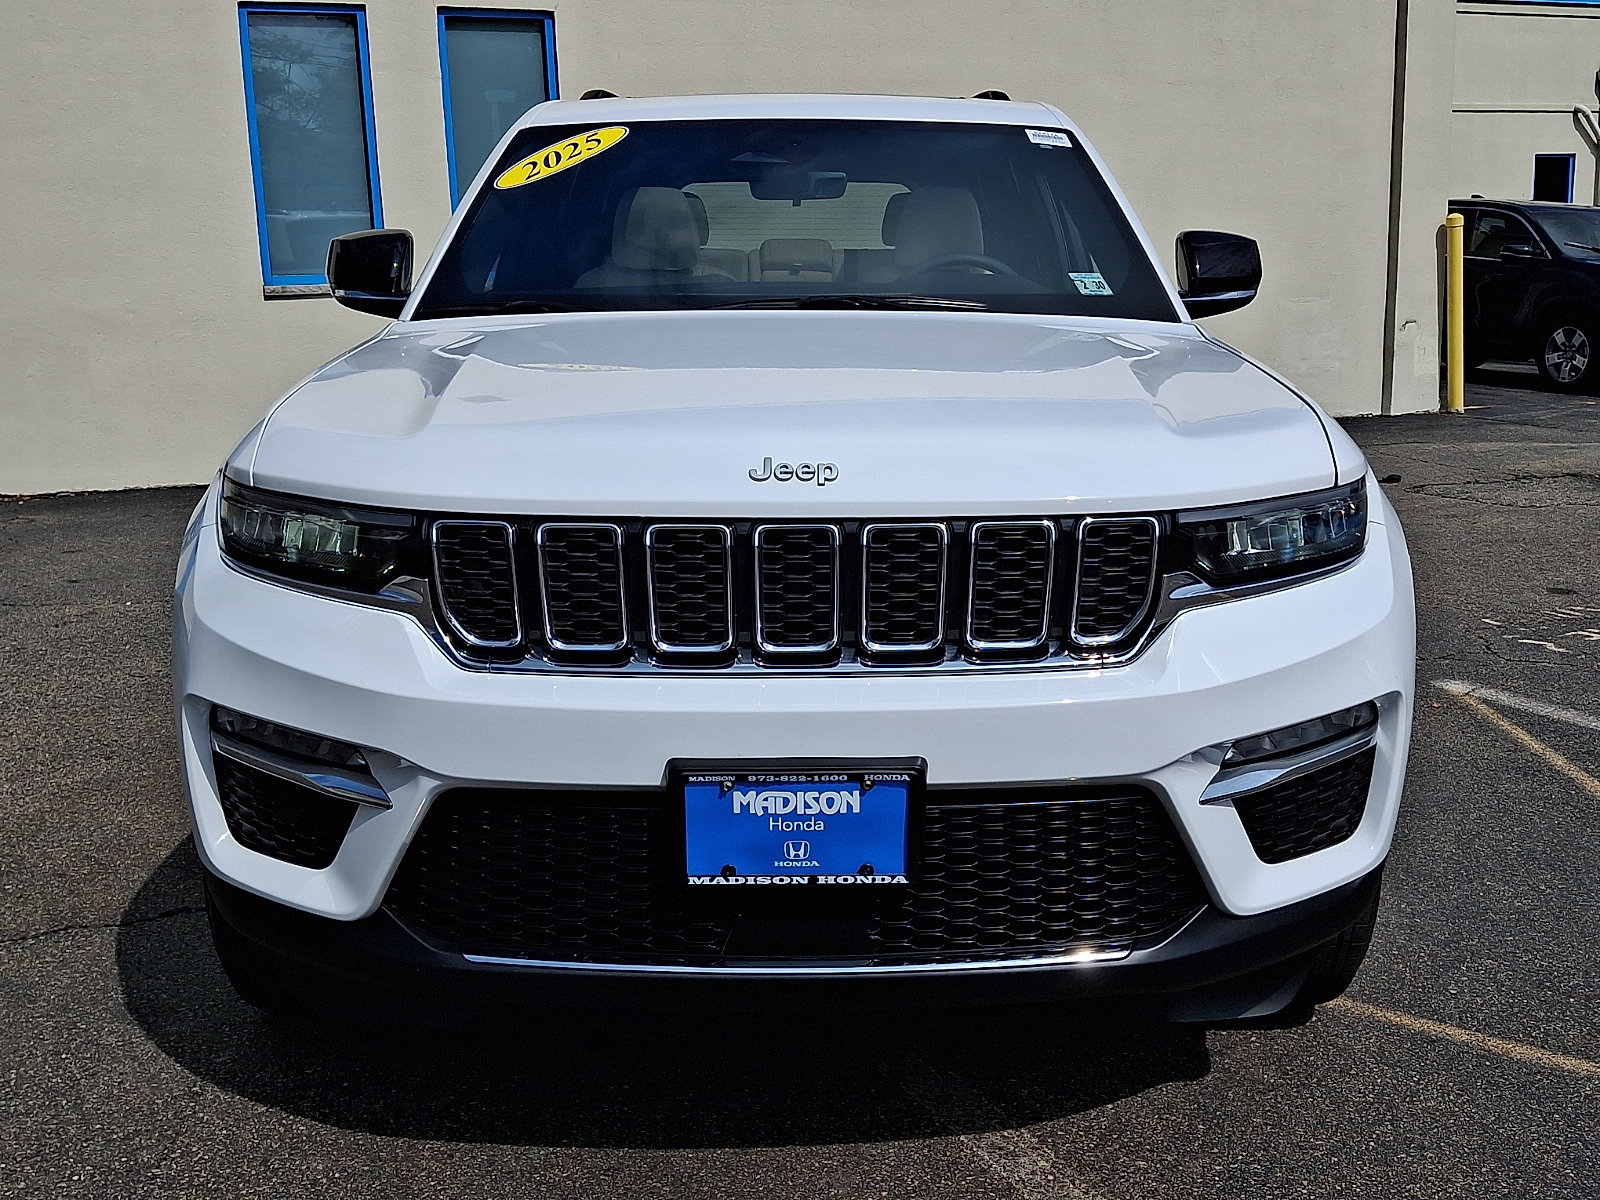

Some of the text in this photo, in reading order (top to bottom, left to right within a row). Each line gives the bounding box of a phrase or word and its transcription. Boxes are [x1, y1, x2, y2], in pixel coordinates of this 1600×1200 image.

[522, 132, 602, 181] 2025
[1081, 281, 1105, 289] 2 30
[748, 456, 839, 487] Jeep
[732, 790, 861, 816] MADISON
[769, 817, 825, 831] Honda
[687, 875, 910, 885] MADISON HONDA
